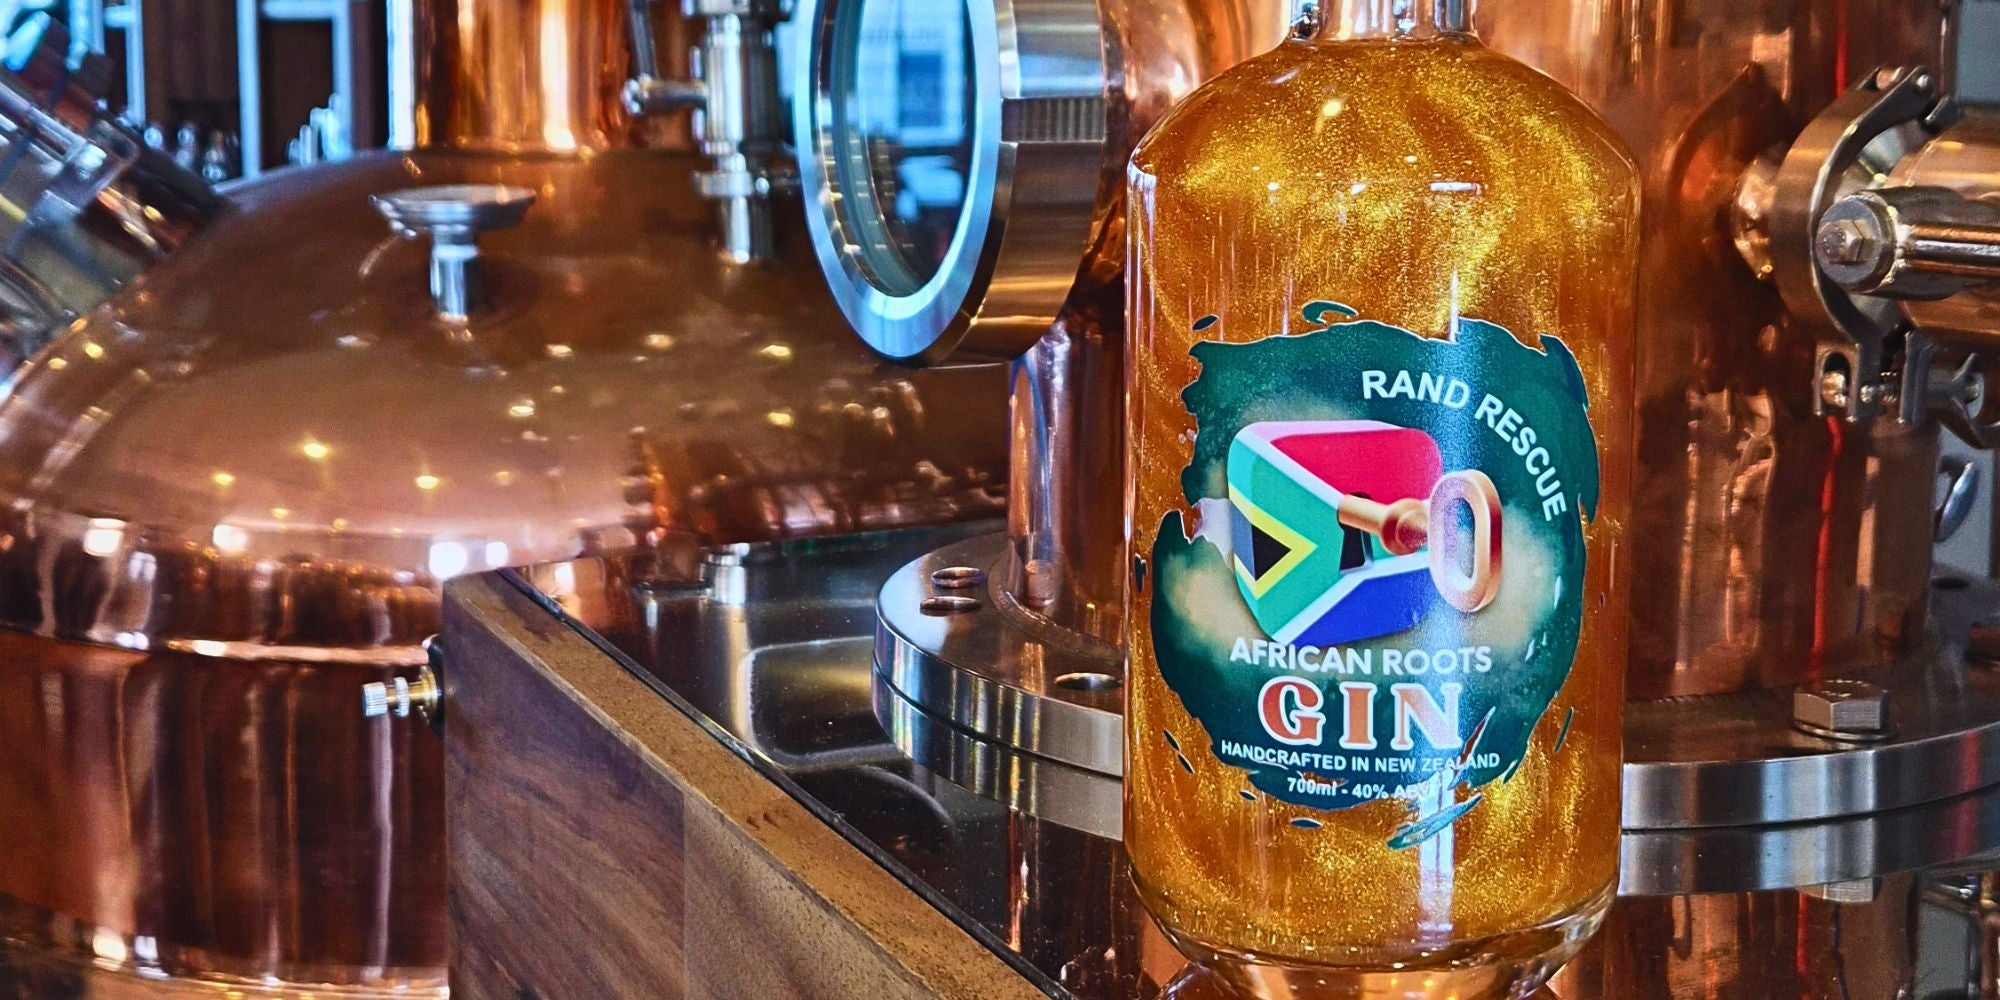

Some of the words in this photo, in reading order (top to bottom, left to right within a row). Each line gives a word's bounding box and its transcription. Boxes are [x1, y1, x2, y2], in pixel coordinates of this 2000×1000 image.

[1362, 370, 1470, 409] RAND
[1475, 393, 1568, 522] RESCUE
[1230, 637, 1372, 675] AFRICAN
[1383, 646, 1492, 675] ROOTS
[1258, 676, 1463, 750] GIN
[1222, 740, 1347, 770] HANDCRAFTED
[1351, 756, 1370, 772] IN
[1375, 757, 1416, 772] NEW
[1421, 753, 1500, 772] ZEALAND
[1288, 777, 1337, 796] 700ml
[1352, 784, 1389, 799] 40%
